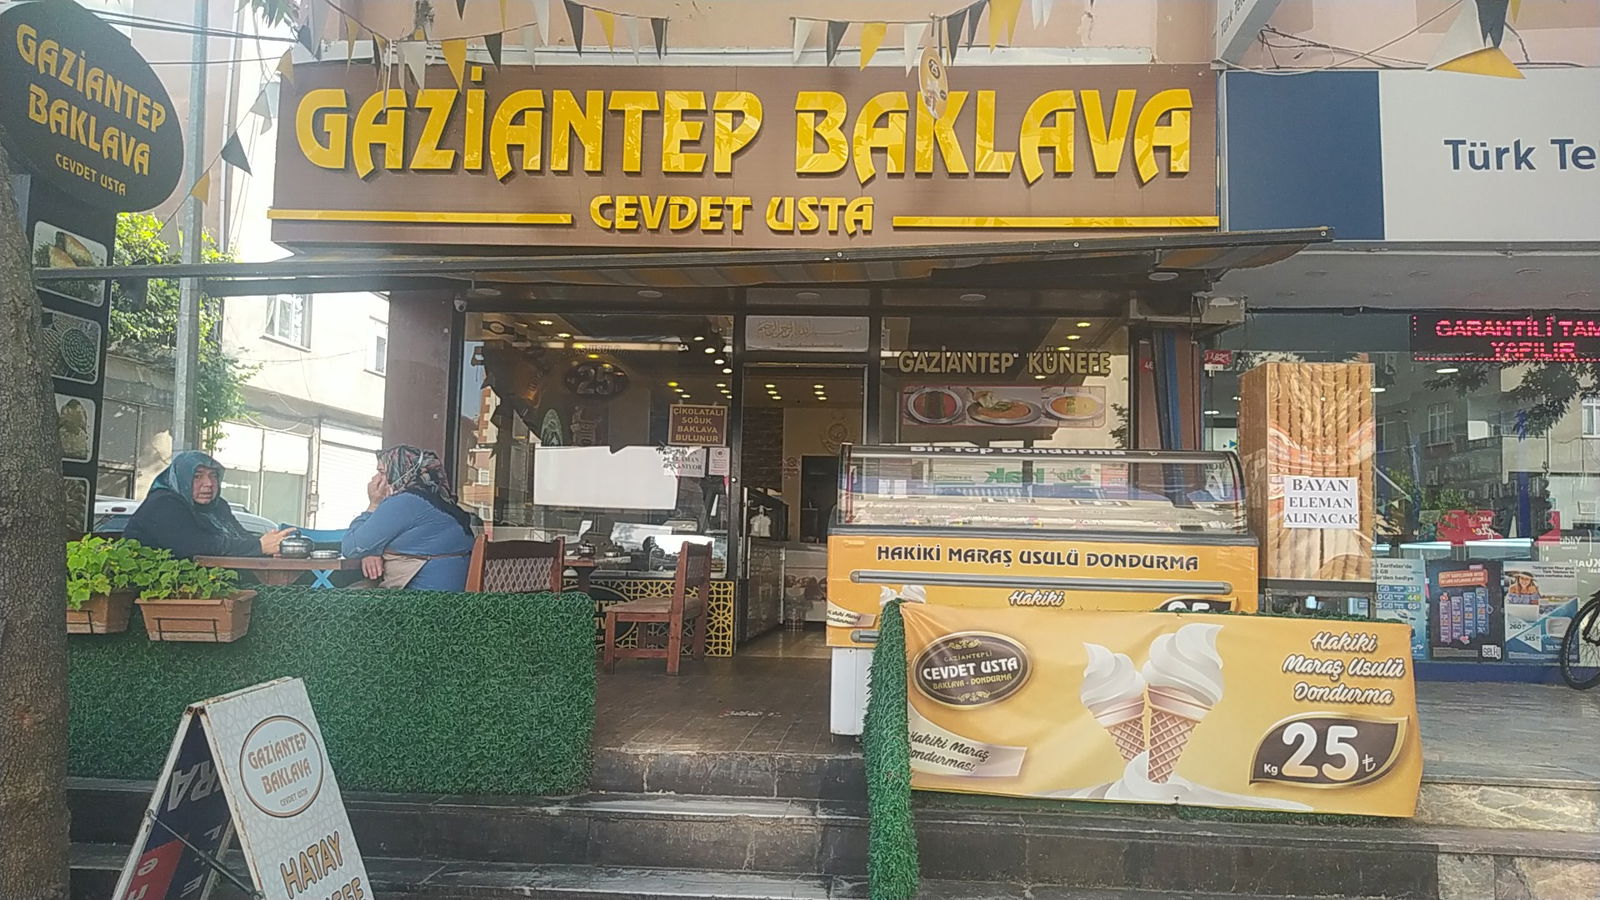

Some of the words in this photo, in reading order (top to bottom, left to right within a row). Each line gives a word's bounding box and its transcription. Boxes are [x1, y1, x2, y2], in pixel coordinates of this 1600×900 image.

[16, 23, 166, 133] GAZİANTEP
[28, 83, 150, 176] BAKLAVA
[295, 65, 764, 181] GAZİANTEP
[795, 88, 1193, 185] BAKLAVA
[1444, 139, 1536, 170] Türk
[56, 153, 97, 183] CEVDET
[100, 174, 126, 197] USTA
[589, 195, 753, 232] CEVDET
[766, 196, 875, 236] USTA
[899, 346, 1015, 374] GAZİANTEP
[1027, 346, 1111, 376] KÜNEFE
[677, 426, 718, 434] BAKLAVA
[681, 415, 712, 425] SOĞUK
[675, 434, 719, 443] BULUNUR
[1292, 479, 1350, 492] BAYAN
[1289, 497, 1353, 509] ELEMAN
[1284, 513, 1358, 524] ALINACAK
[877, 544, 941, 561] HAKİKİ
[948, 548, 1013, 568] MARAŞ
[1019, 550, 1079, 566] USULÜ
[1086, 553, 1198, 571] DONDURMA
[1008, 589, 1065, 607] Hakiki
[1310, 632, 1378, 653] Hakiki
[922, 662, 978, 681] CEVDET
[980, 657, 1019, 674] USTA
[1282, 655, 1345, 681] Maraş
[1347, 657, 1405, 679] Usulü
[932, 679, 965, 690] BAKLAVA
[970, 673, 1012, 686] DONDURMA
[1293, 682, 1395, 705] Dondurma
[247, 732, 307, 770] GAZİANTEP
[948, 741, 990, 763] Maraş
[1263, 763, 1278, 776] Kg
[1280, 721, 1360, 781] 25
[261, 757, 313, 796] BAKLAVA
[279, 830, 344, 900] HATAY
